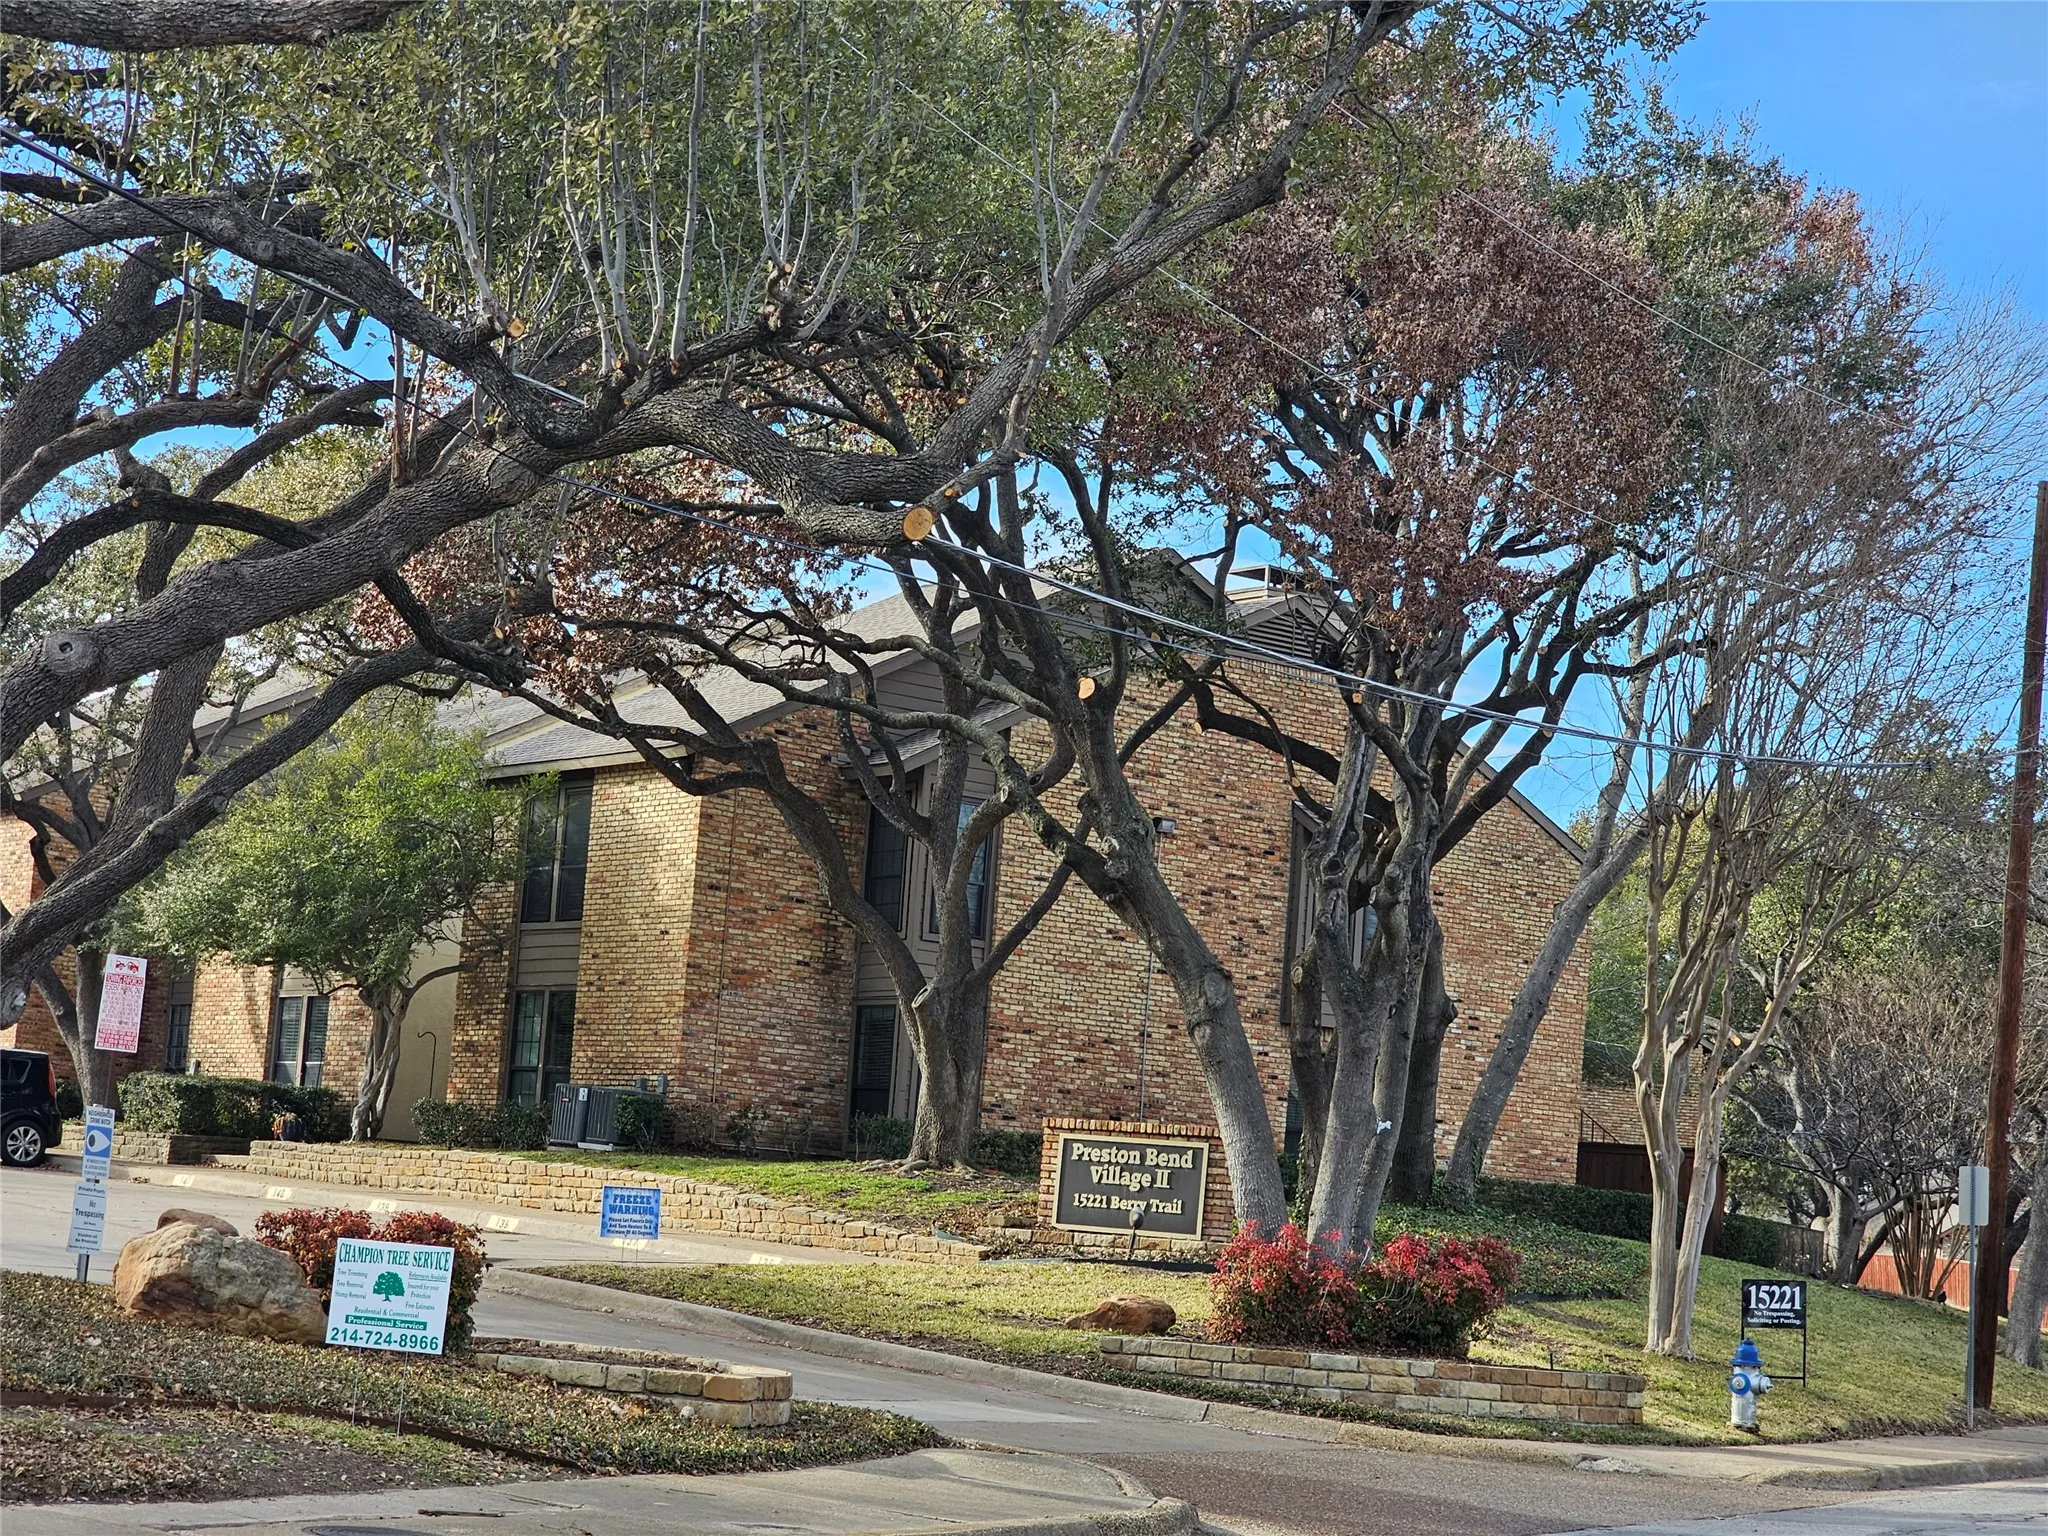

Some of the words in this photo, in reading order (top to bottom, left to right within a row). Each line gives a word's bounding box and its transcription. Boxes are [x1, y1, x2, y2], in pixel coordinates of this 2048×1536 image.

[1071, 1143, 1141, 1165] Preston
[1145, 1148, 1193, 1168] Bend
[1090, 1164, 1152, 1192] Village
[1153, 1168, 1171, 1188] II
[612, 1194, 652, 1205] FREEZE
[1073, 1193, 1107, 1208] 15221
[1110, 1196, 1147, 1212] Berry
[1149, 1198, 1182, 1214] Trail
[75, 1208, 104, 1220] Trespassing
[608, 1204, 655, 1216] WARNING
[339, 1242, 384, 1265] CHAMPION
[386, 1250, 410, 1266] TREE
[412, 1250, 450, 1272] SERVICE
[348, 1269, 368, 1278] Trimming
[408, 1271, 429, 1280] References
[429, 1273, 448, 1281] Available
[346, 1280, 364, 1288] Removal
[407, 1282, 423, 1290] Insured
[334, 1290, 348, 1299] Stump
[348, 1291, 367, 1299] Removal
[410, 1291, 431, 1299] Protection
[1748, 1285, 1802, 1310] 15221
[405, 1301, 414, 1309] Free
[415, 1302, 435, 1311] Estimates
[354, 1306, 382, 1315] Residential
[382, 1308, 387, 1316] &
[388, 1309, 420, 1319] Commercial
[347, 1315, 393, 1327] Professional
[396, 1320, 424, 1330] Service
[330, 1327, 439, 1351] 214-724-8966
